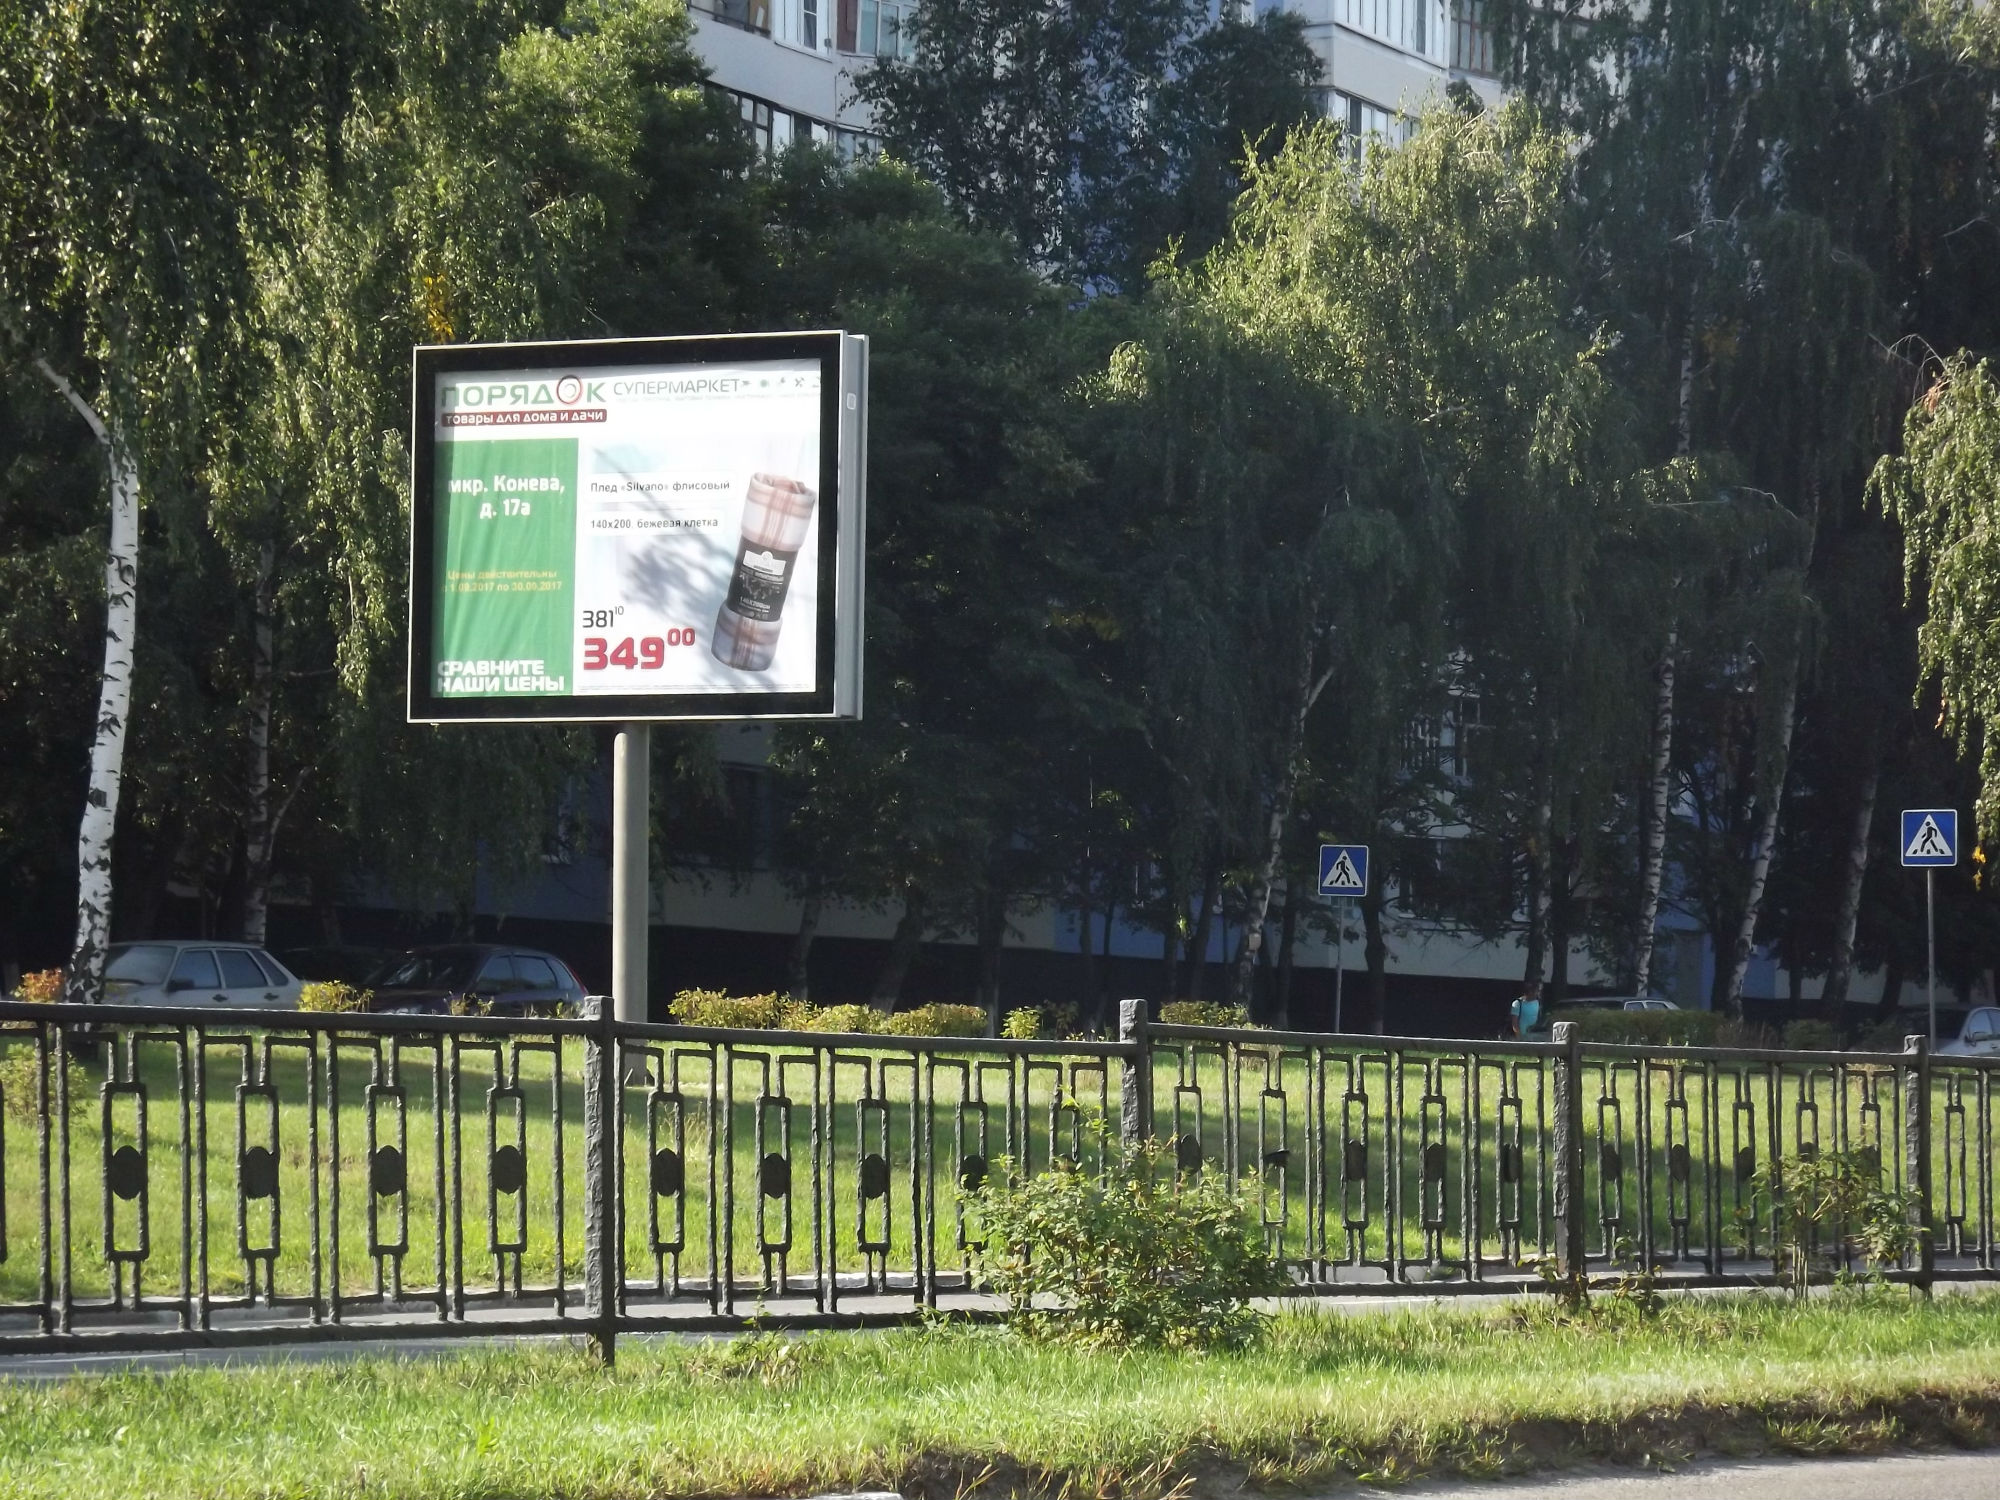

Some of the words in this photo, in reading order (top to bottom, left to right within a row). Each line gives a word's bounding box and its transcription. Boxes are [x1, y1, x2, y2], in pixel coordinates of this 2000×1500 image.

[441, 375, 607, 407] ПОРЯДОК
[613, 378, 740, 396] СУПЕРМАРКЕТ
[445, 412, 493, 426] товары
[496, 413, 521, 423] для
[523, 412, 557, 423] дома
[560, 411, 569, 422] и
[571, 411, 604, 422] дачи
[448, 479, 489, 497] мкр.
[493, 475, 565, 494] Конева,
[590, 482, 617, 494] Плед
[672, 480, 730, 492] флисовый
[479, 502, 497, 520] д.
[503, 499, 531, 516] 17а
[637, 518, 681, 528] бежевая
[684, 518, 719, 528] клетка
[582, 610, 614, 628] 381
[583, 636, 665, 670] 349
[667, 627, 696, 646] 00
[437, 659, 544, 677] СРАВНИТЕ
[437, 676, 500, 693] НАШИ
[504, 676, 564, 693] ЦЕНЫ
